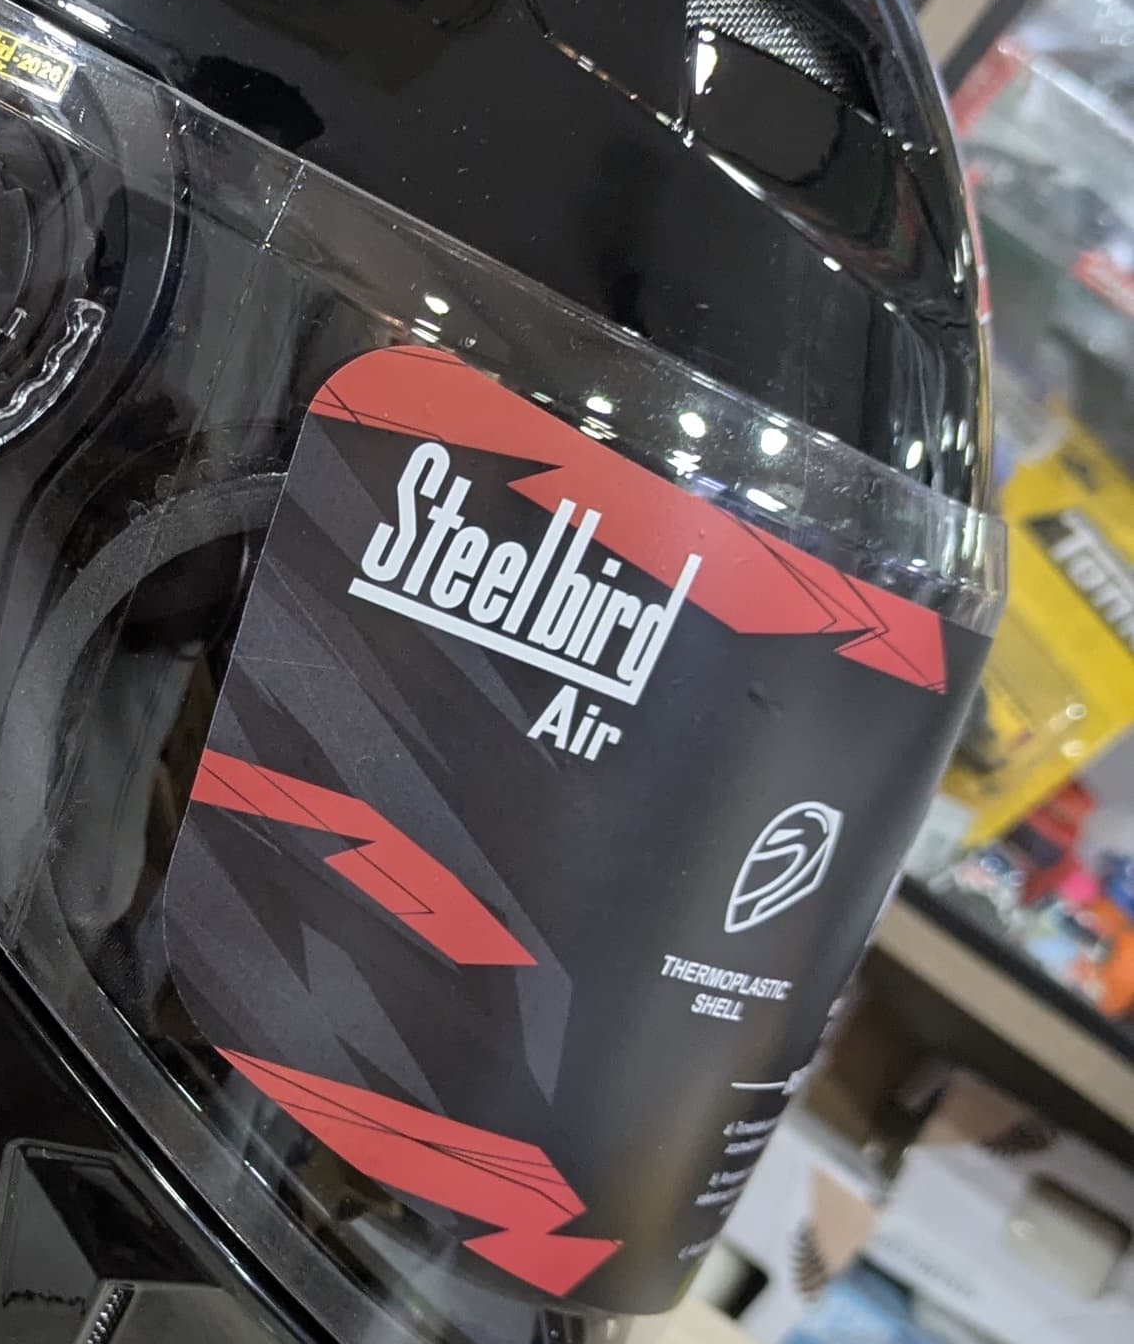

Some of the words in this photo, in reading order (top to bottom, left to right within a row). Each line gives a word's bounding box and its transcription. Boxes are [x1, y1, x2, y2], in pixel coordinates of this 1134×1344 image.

[348, 442, 702, 705] Steelbird
[527, 685, 622, 761] Air
[661, 954, 793, 1000] THERMOPLASTIC
[691, 993, 744, 1022] SHELL
